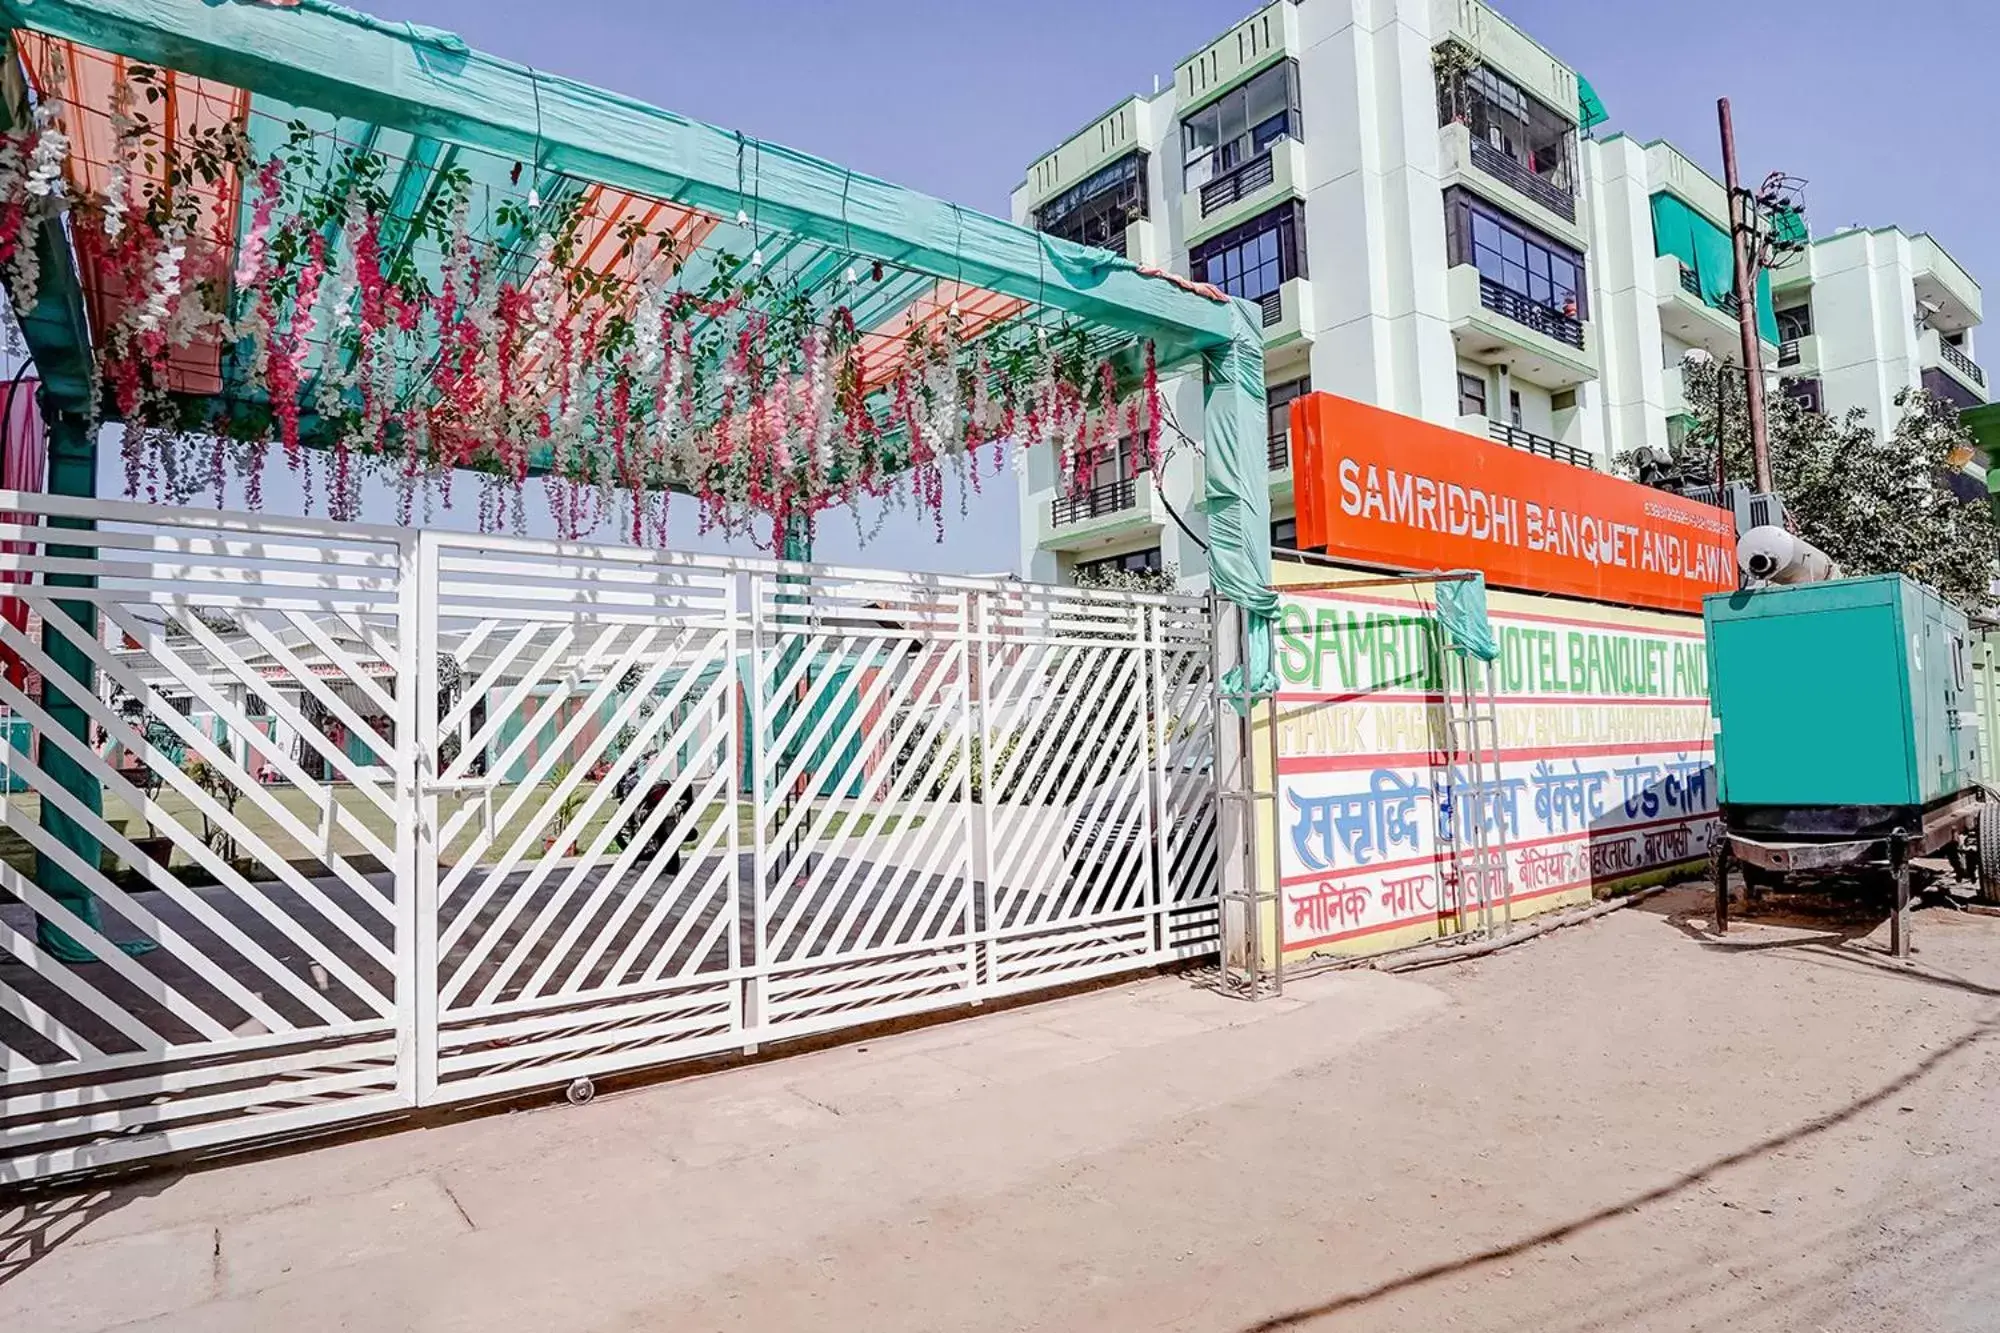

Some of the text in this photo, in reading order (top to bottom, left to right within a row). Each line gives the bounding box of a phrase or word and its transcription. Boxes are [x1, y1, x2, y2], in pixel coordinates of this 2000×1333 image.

[1338, 456, 1519, 547] SAMRIDDHI
[1526, 502, 1640, 569] BANQUET
[1641, 529, 1681, 575] AND
[1682, 535, 1734, 587] LAWN
[1568, 631, 1668, 697] BANQUET
[1381, 874, 1437, 917] नगर
